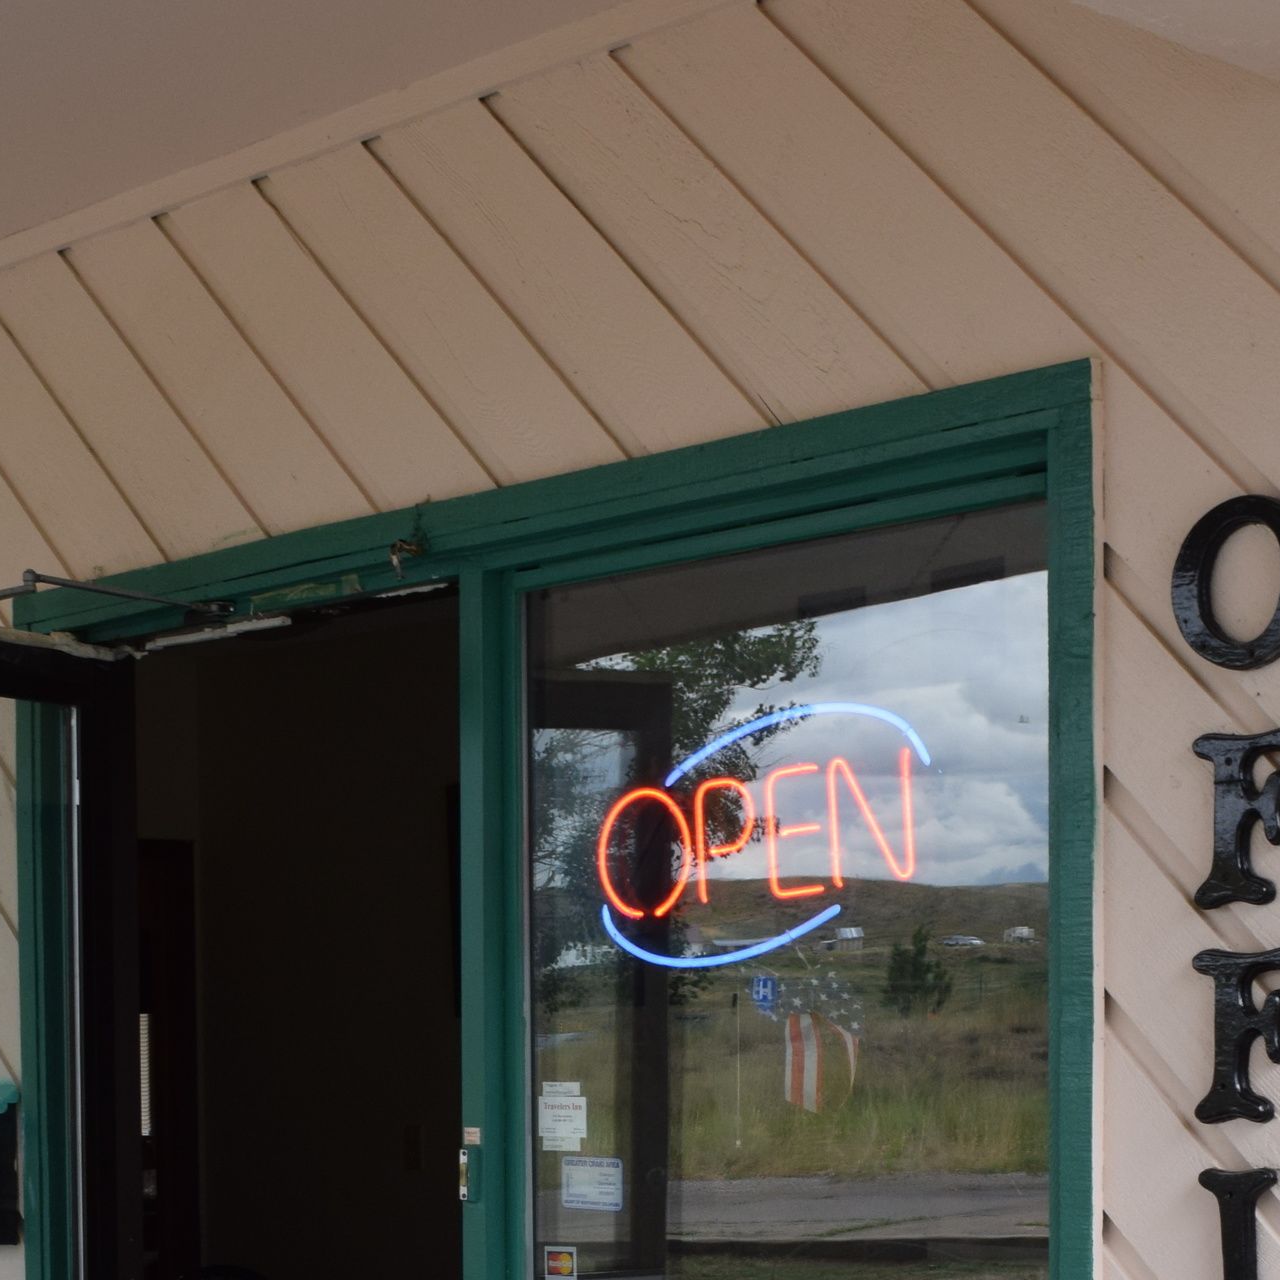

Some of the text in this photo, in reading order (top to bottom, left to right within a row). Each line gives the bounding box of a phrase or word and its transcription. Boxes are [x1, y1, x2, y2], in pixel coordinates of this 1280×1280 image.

[597, 746, 916, 919] OPEN
[543, 1102, 583, 1111] Travelers Inn
